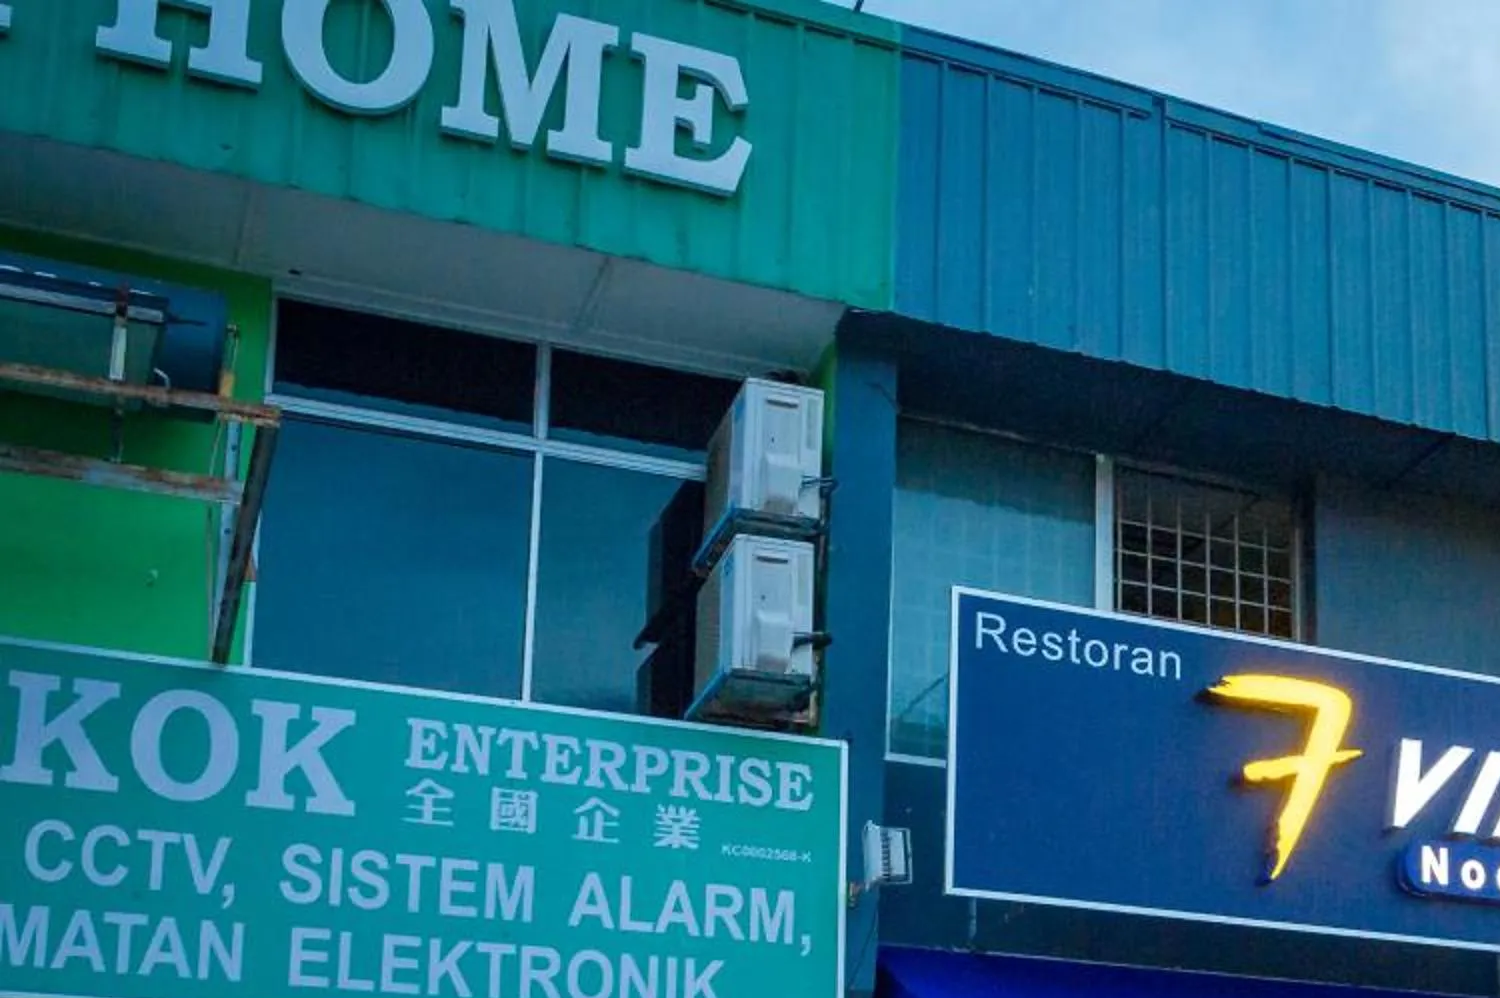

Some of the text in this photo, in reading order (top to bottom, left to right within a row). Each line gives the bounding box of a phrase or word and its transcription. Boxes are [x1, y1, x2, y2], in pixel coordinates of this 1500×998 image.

[975, 611, 1182, 681] Restoran
[0, 670, 356, 816] KOK
[404, 718, 815, 811] ENTERPRISE
[1204, 673, 1364, 882] 7
[402, 778, 700, 849] 全國企業
[24, 818, 812, 956] CCTV, SISTEM ALARM,
[0, 903, 245, 981] MATAN
